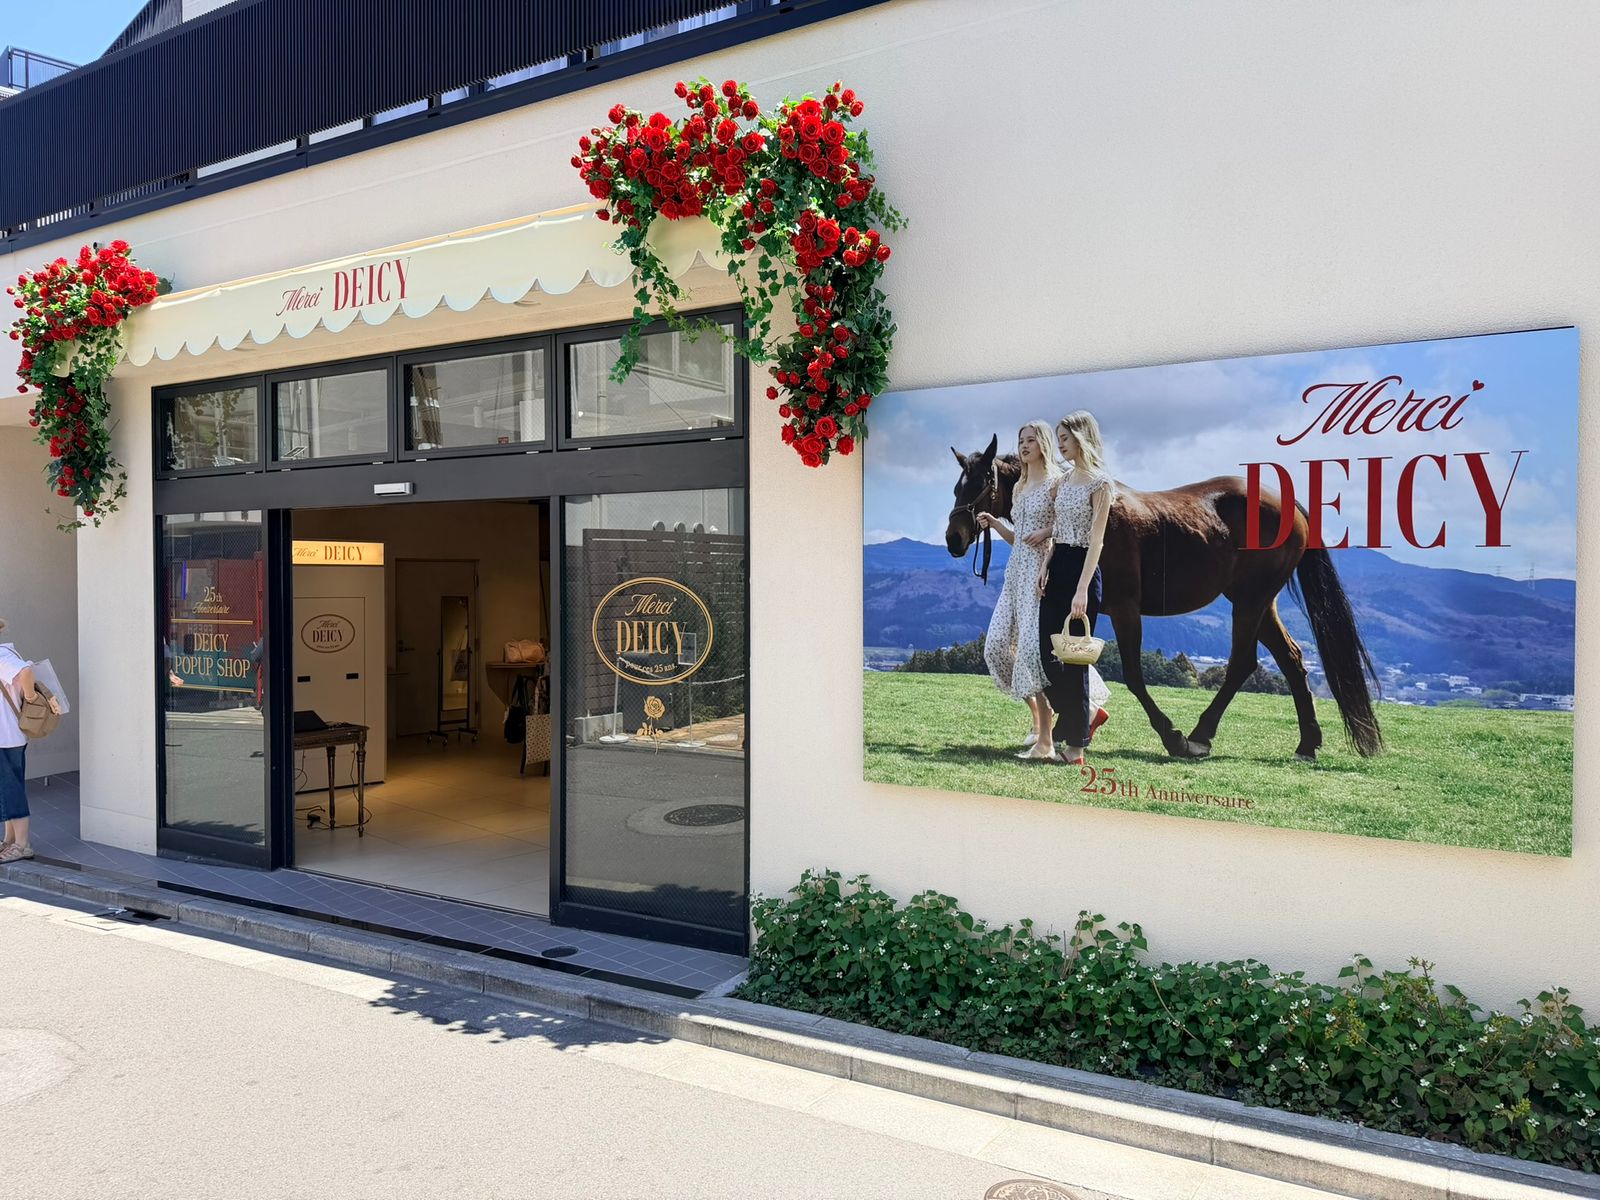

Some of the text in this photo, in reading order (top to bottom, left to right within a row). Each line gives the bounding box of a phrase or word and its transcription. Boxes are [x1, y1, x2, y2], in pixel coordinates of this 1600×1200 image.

[276, 257, 411, 316] Merci DEICY
[1276, 375, 1485, 446] Merci
[1238, 450, 1529, 551] DEICY
[324, 545, 365, 561] DEICY
[203, 586, 223, 602] 25th
[625, 593, 678, 616] Merci
[193, 633, 229, 652] DEICY
[312, 629, 344, 643] DEICY
[615, 620, 688, 655] DEICY
[175, 656, 251, 678] POPUP SHOP
[654, 664, 664, 673] 25
[1080, 765, 1255, 810] 25th Anniversaire
